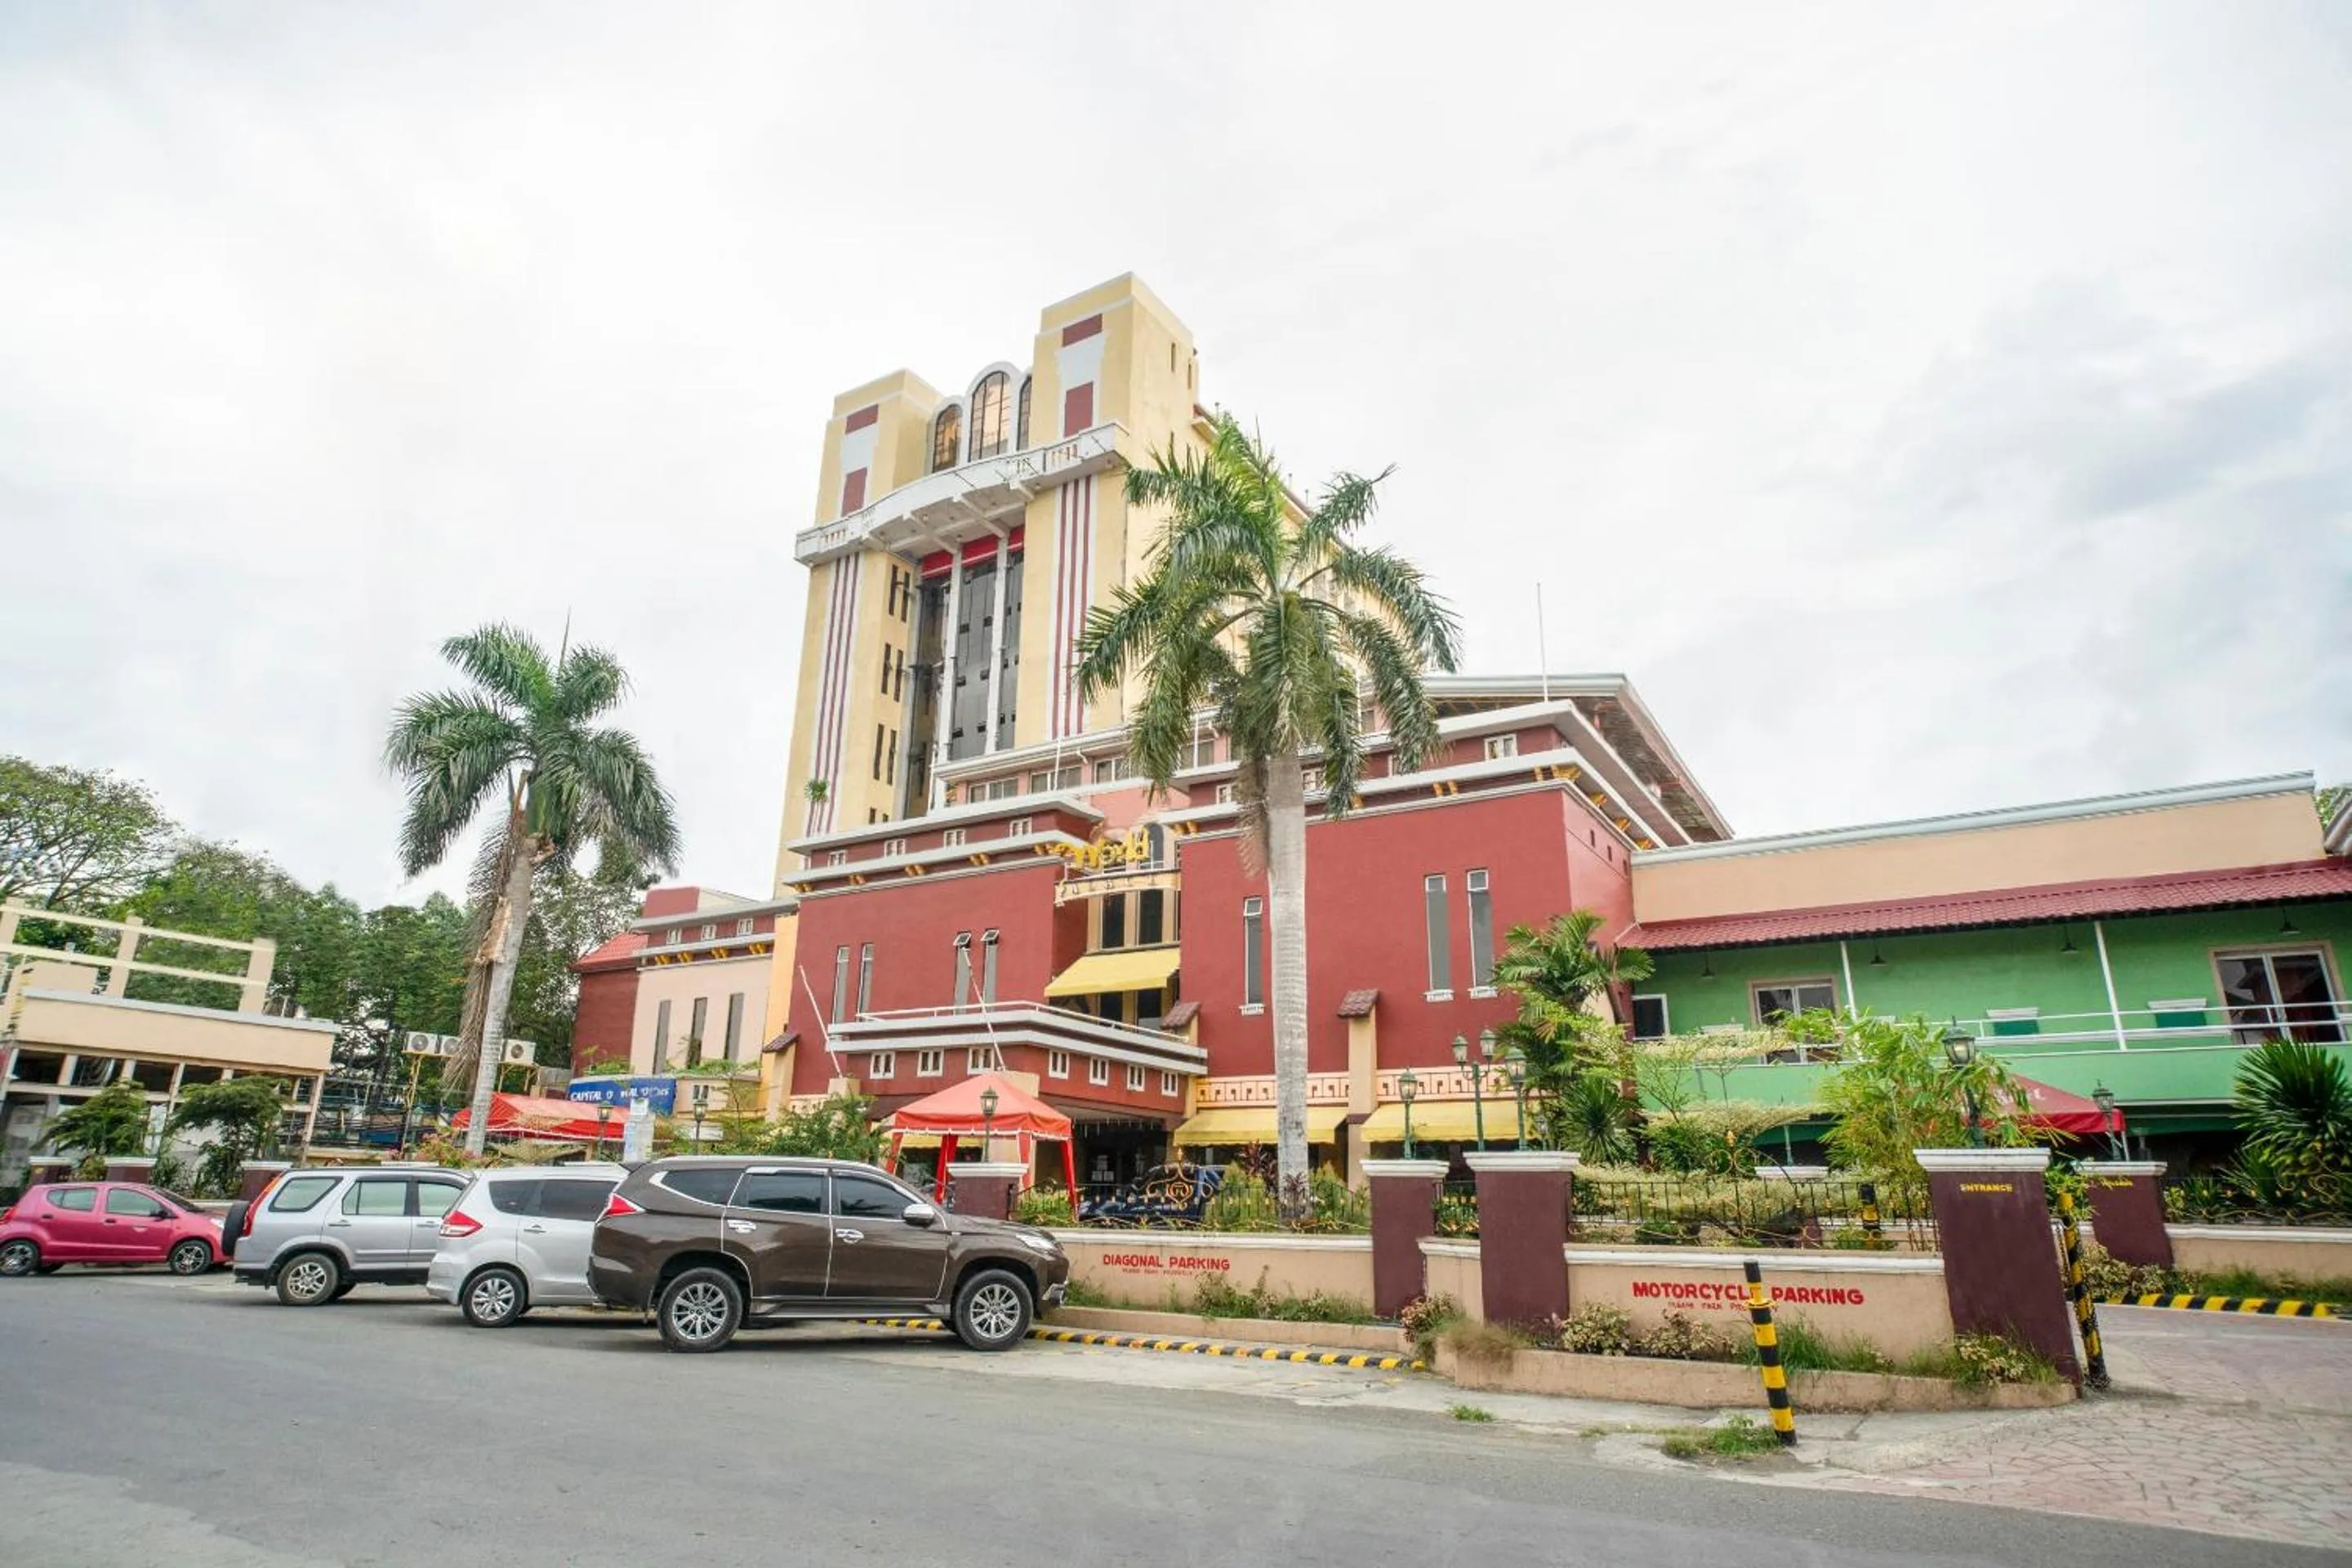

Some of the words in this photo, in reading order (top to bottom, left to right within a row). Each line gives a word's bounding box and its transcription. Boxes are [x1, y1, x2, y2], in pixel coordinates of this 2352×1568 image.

[1960, 1183, 2013, 1192] ENTRANCE
[1103, 1254, 1163, 1267] DIAGONAL
[1169, 1256, 1231, 1271] PARKING
[1771, 1286, 1864, 1305] PARKING
